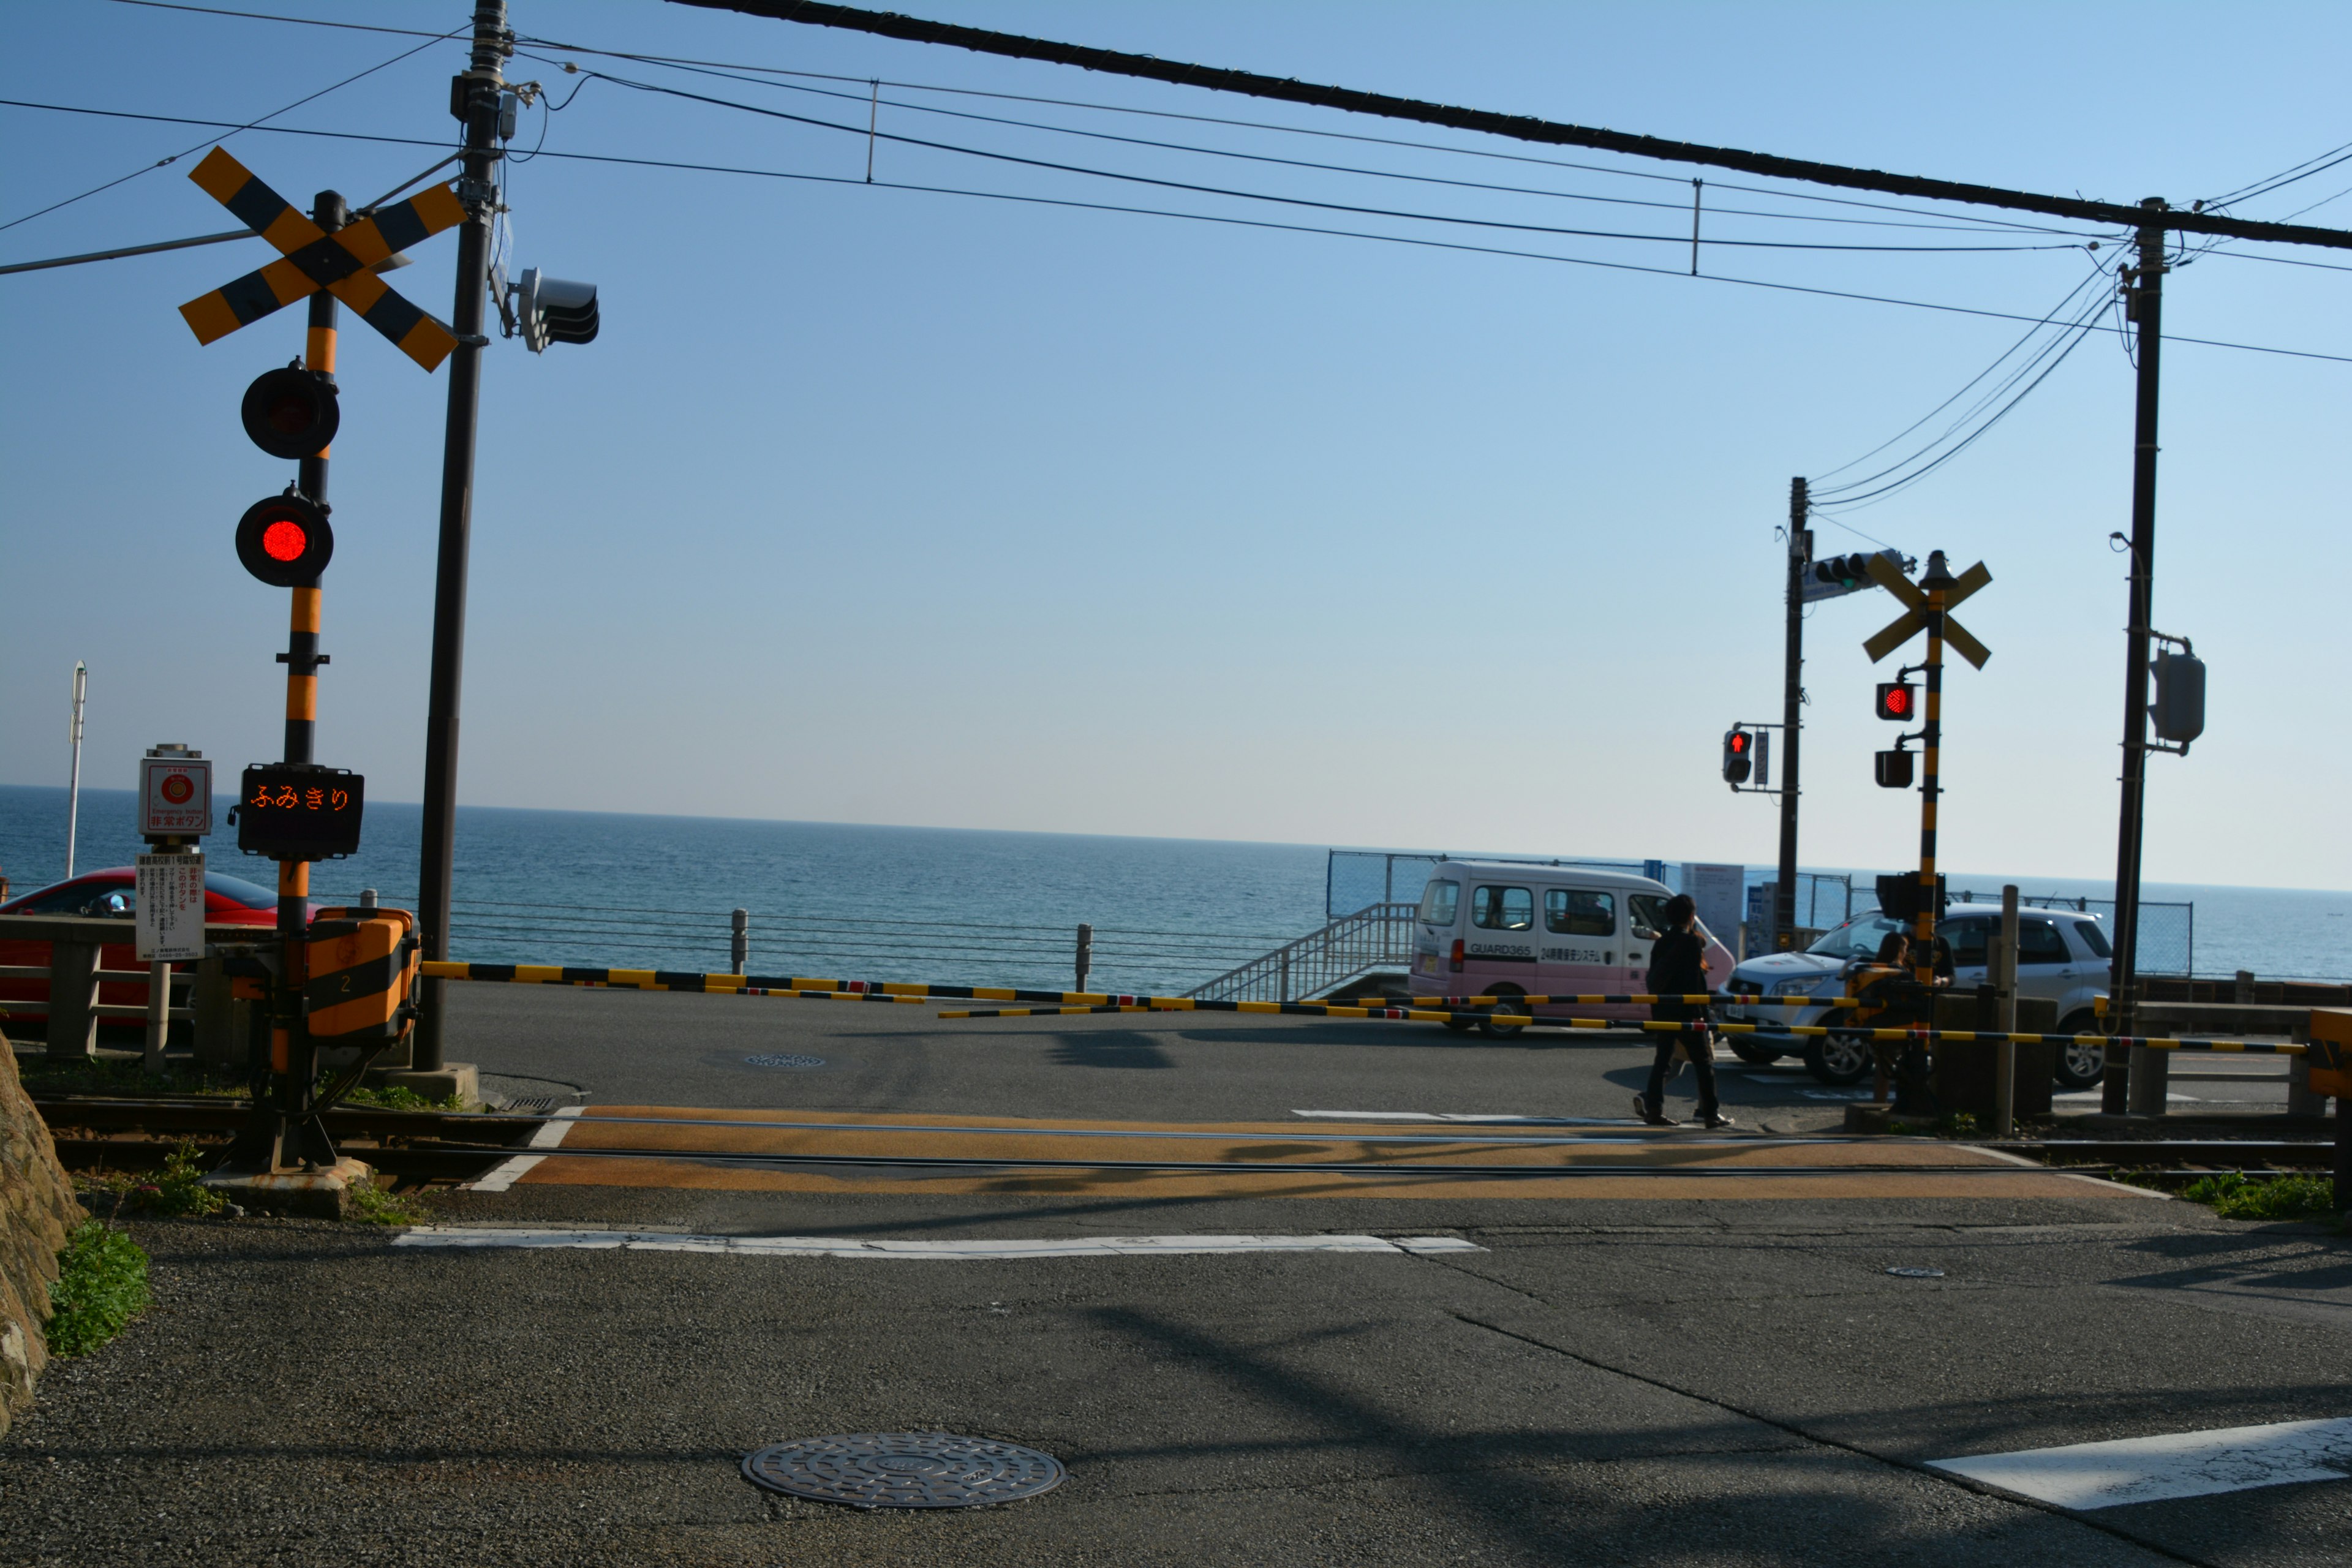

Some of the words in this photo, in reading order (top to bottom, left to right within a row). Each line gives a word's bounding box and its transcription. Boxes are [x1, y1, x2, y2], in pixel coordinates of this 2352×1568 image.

[251, 785, 348, 811] ふみきり
[151, 815, 203, 827] 非常ボタン
[1471, 943, 1531, 956] GUARD365
[1540, 948, 1600, 962] 24時間保安システム
[341, 975, 350, 992] 2
